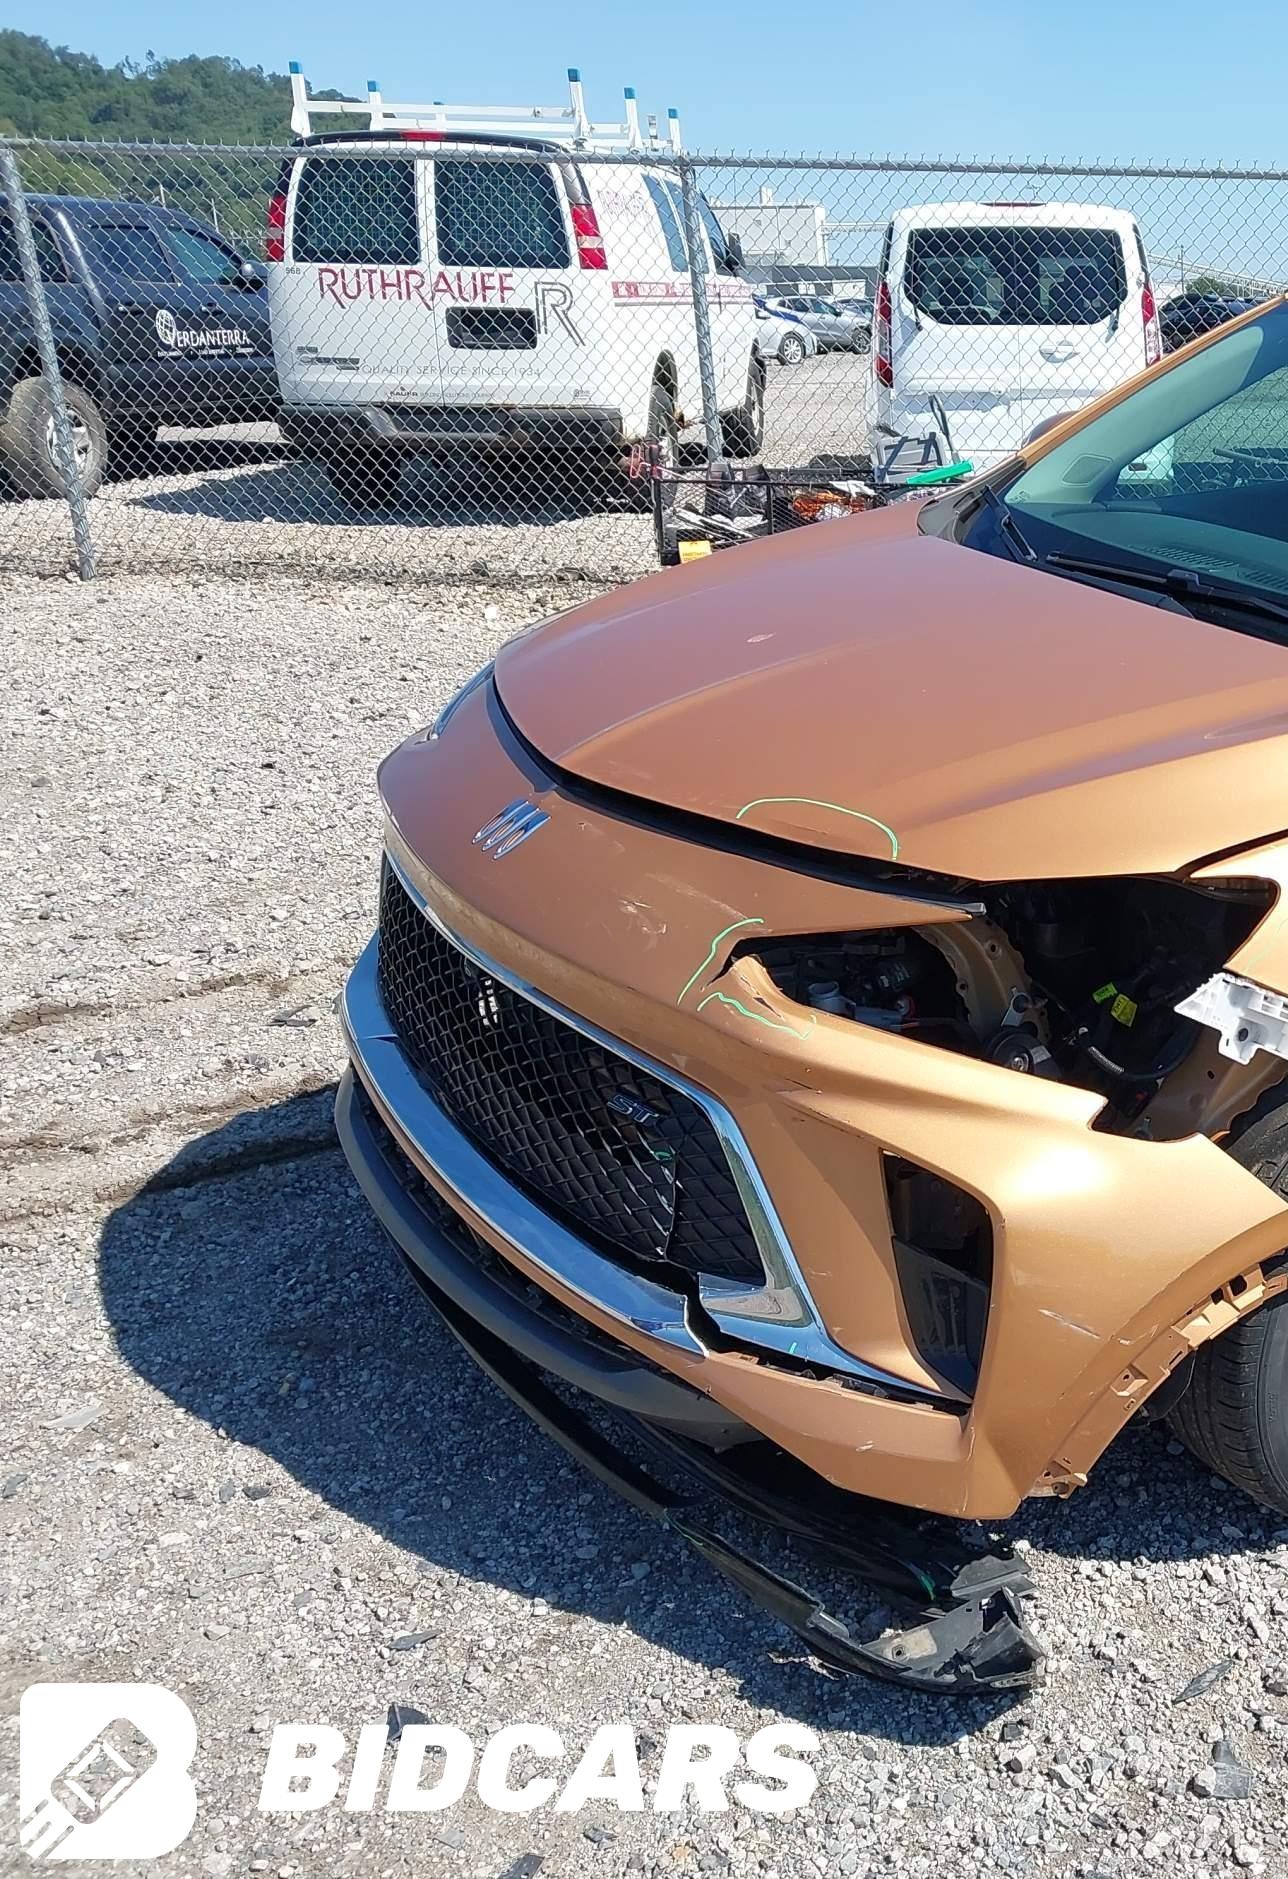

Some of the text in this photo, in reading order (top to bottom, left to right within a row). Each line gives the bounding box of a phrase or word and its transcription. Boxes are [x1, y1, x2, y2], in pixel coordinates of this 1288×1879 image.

[317, 267, 515, 310] RUTHRAUFF
[534, 281, 586, 347] R
[362, 364, 542, 376] QUALITY SERVICE SINCE 1934
[606, 1094, 660, 1123] ST
